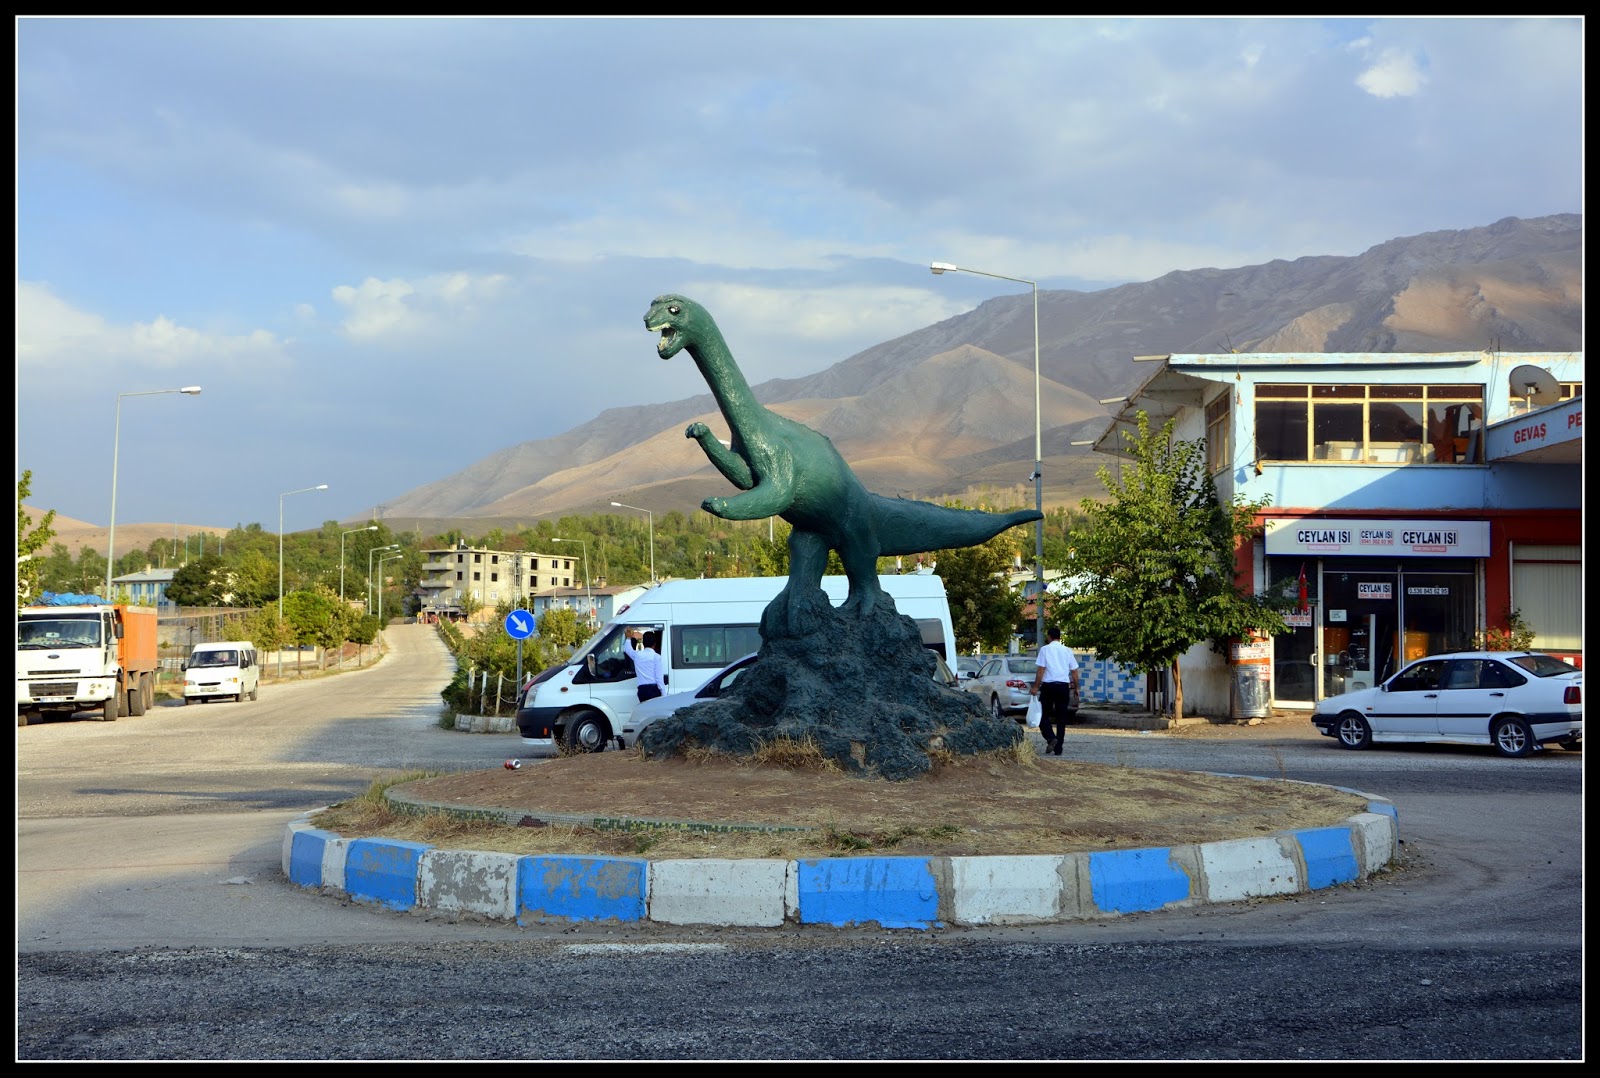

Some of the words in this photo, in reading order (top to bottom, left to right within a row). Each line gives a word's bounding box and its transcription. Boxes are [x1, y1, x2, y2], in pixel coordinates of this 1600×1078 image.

[1514, 423, 1547, 444] GEVAŞ
[1298, 530, 1336, 543] CEYLAN
[1338, 531, 1351, 543] ISI
[1361, 530, 1384, 539] CEYLAN
[1385, 531, 1393, 539] ISI
[1403, 531, 1441, 544] CEYLAN
[1444, 532, 1456, 544] ISI
[1359, 584, 1382, 593] CEYLAN
[1383, 584, 1391, 592] ISI
